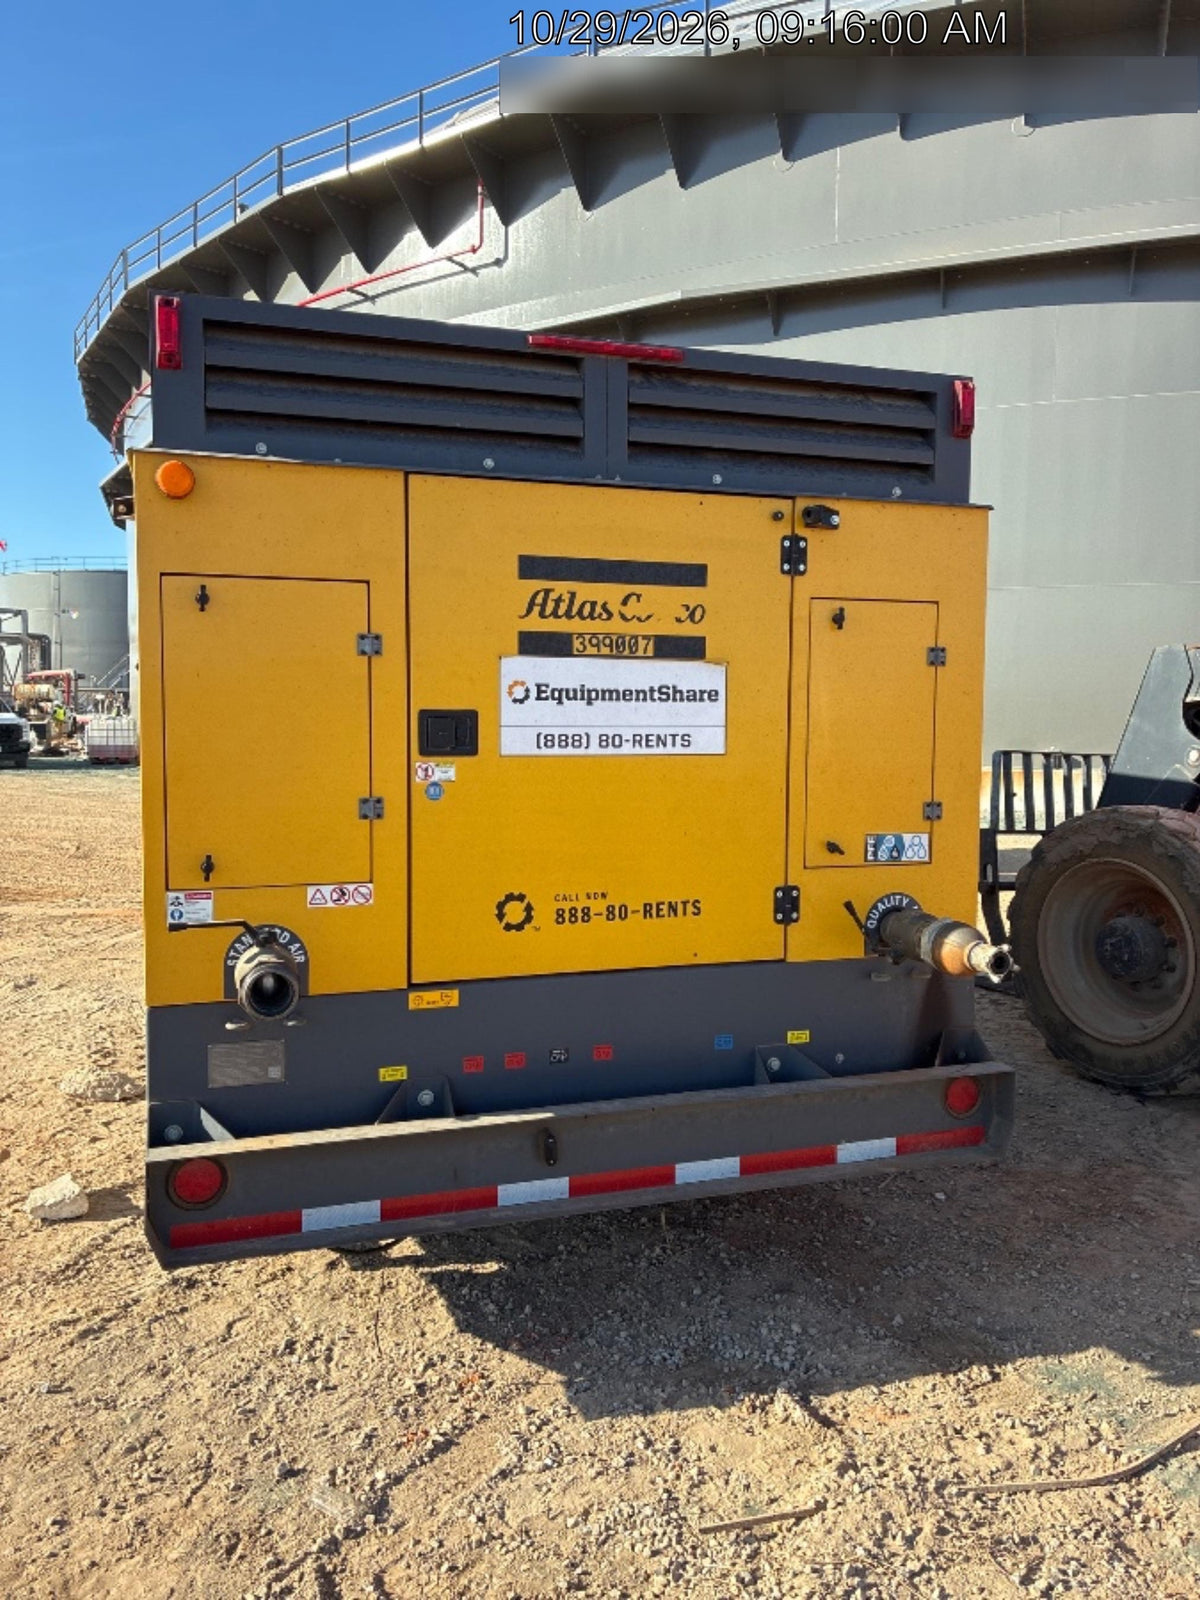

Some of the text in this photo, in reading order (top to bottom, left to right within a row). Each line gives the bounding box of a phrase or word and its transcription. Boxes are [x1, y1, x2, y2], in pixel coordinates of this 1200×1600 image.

[518, 587, 614, 622] Atlas
[575, 634, 652, 655] 399007
[534, 683, 720, 706] EquipmentShare
[536, 731, 692, 750] (888) 80-RENTS
[554, 893, 579, 902] CALL
[554, 899, 702, 925] 888-80-RENTS
[867, 895, 910, 929] QUALITY
[287, 943, 306, 963] AIR
